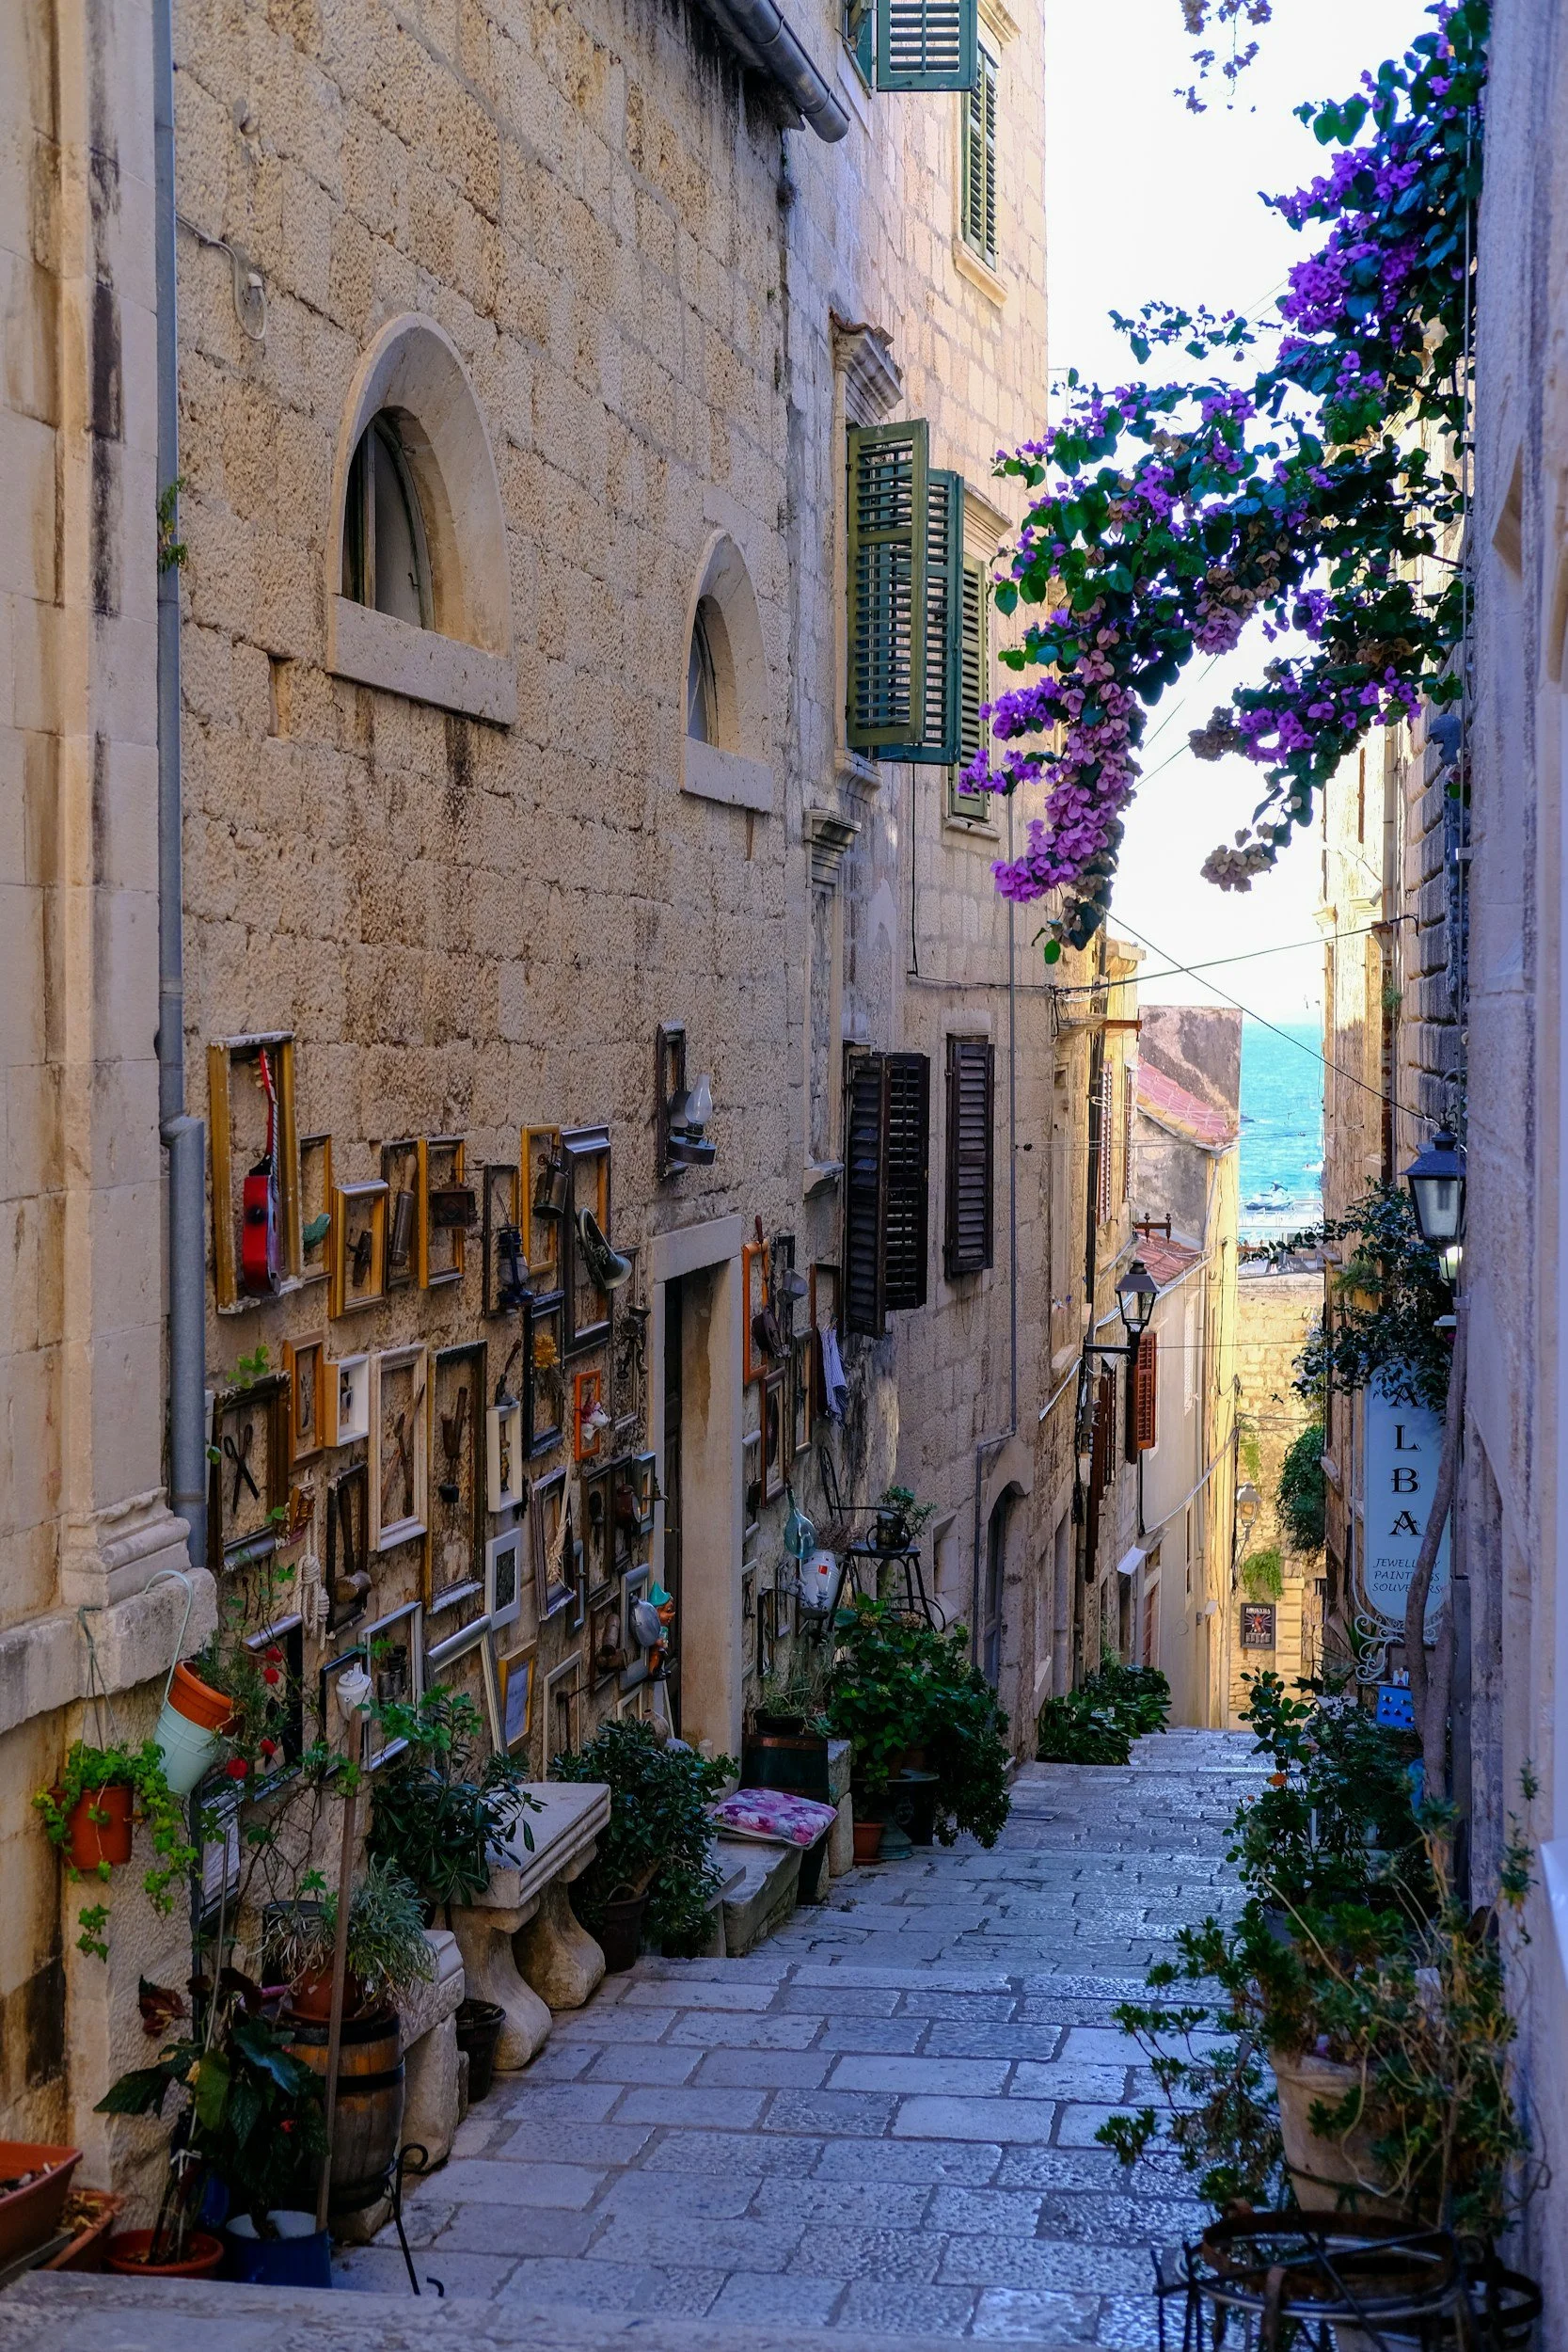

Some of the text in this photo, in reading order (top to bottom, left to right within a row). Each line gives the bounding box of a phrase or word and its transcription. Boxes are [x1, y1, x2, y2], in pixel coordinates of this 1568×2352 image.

[1388, 1382, 1424, 1538] ALBA
[1373, 1558, 1441, 1568] JEWELLY
[1374, 1571, 1440, 1581] PAINTGS
[1372, 1583, 1441, 1594] SOUVERS
